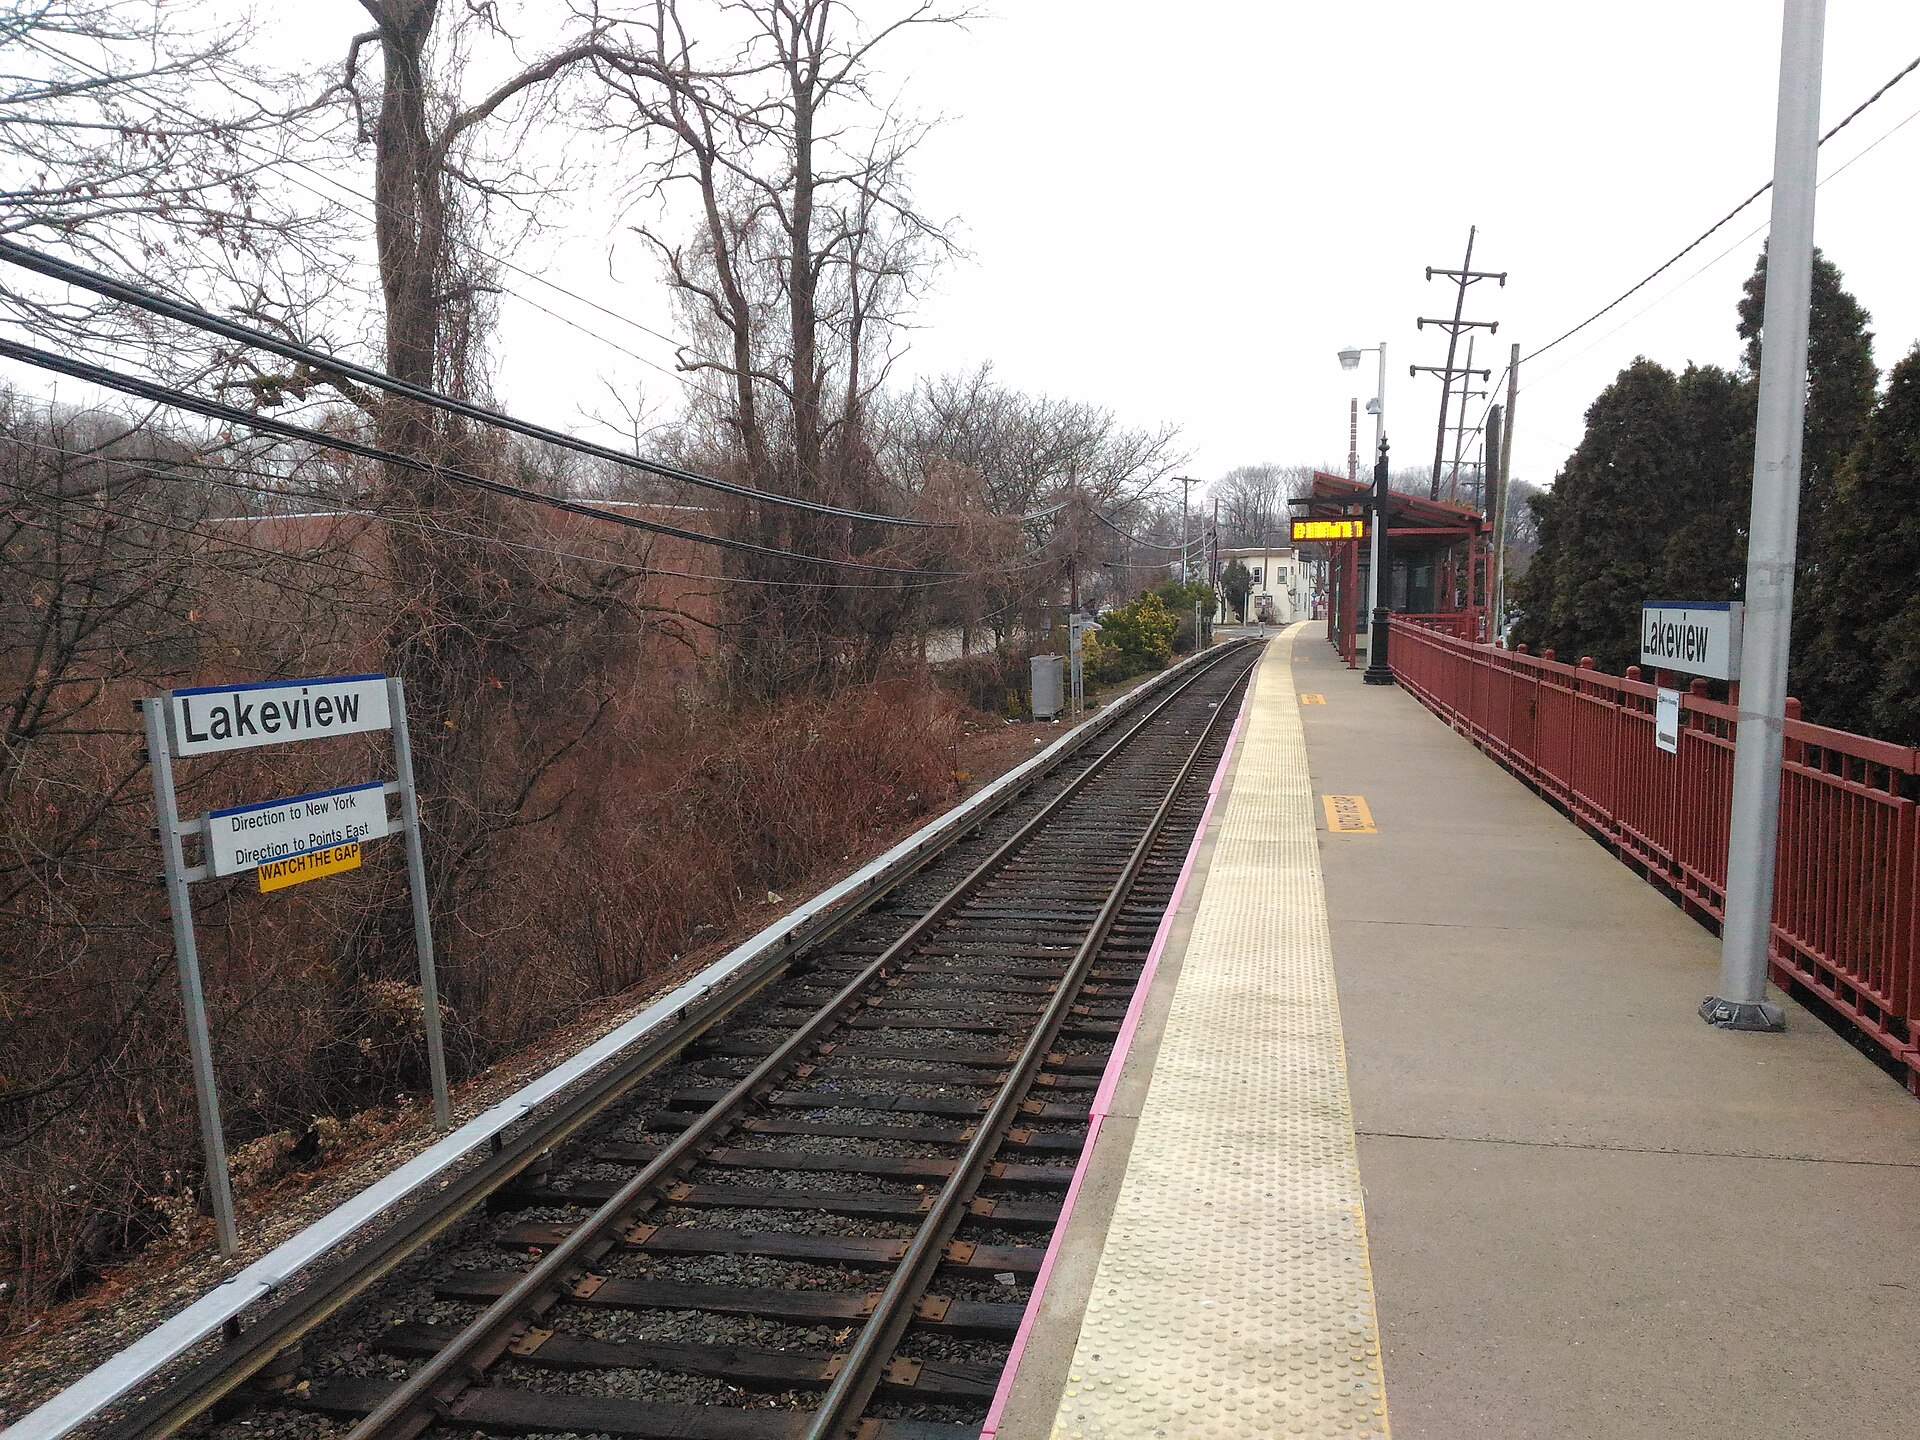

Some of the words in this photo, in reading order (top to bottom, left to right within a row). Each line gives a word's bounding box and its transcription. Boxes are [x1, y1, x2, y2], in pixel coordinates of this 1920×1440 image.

[1643, 610, 1708, 663] Lakeview
[181, 687, 359, 743] Lakeview
[231, 811, 285, 833] Direction
[289, 807, 301, 819] to
[305, 801, 329, 817] New
[332, 795, 356, 811] York
[235, 842, 289, 866] Direction
[293, 838, 305, 850] to
[308, 829, 342, 849] Points
[345, 822, 369, 838] East
[260, 856, 306, 881] WATCH
[308, 851, 332, 869] THE
[333, 844, 359, 862] GAP
